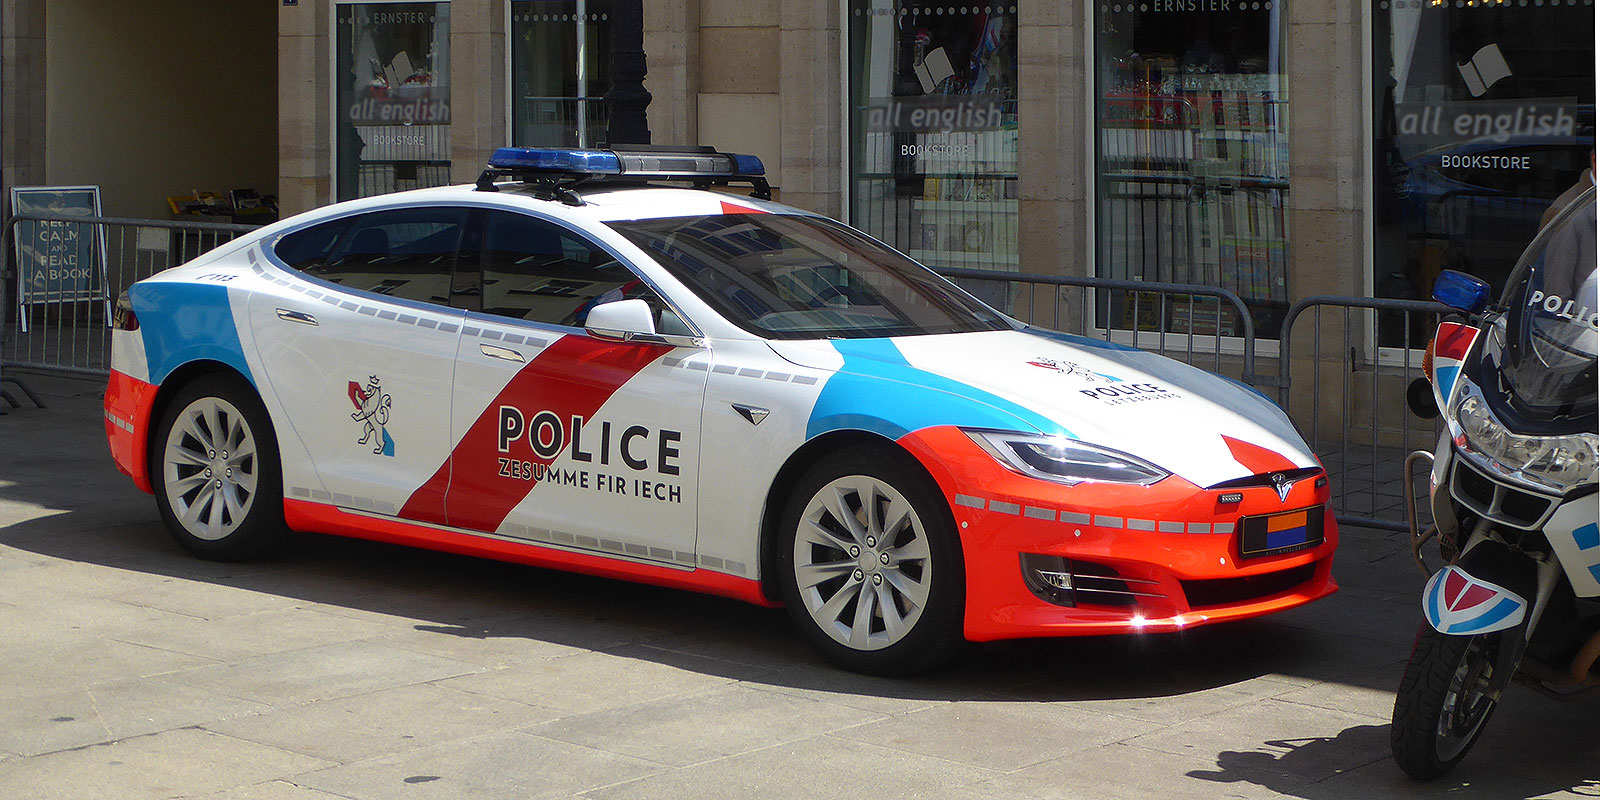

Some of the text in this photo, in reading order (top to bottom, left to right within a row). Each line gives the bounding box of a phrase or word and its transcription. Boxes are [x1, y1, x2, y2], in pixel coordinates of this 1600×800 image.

[374, 12, 424, 24] ERNSTER
[350, 98, 450, 126] all english
[868, 101, 1001, 133] all english
[1400, 105, 1574, 143] all english
[373, 135, 425, 146] BOOKSTORE
[901, 144, 969, 157] BOOKSTORE
[1441, 155, 1531, 170] BOOKSTORE
[34, 268, 91, 280] A BOOK
[1079, 383, 1167, 400] POLICE
[498, 405, 682, 476] POLICE
[498, 457, 682, 504] ZESUMME FIR IECH
